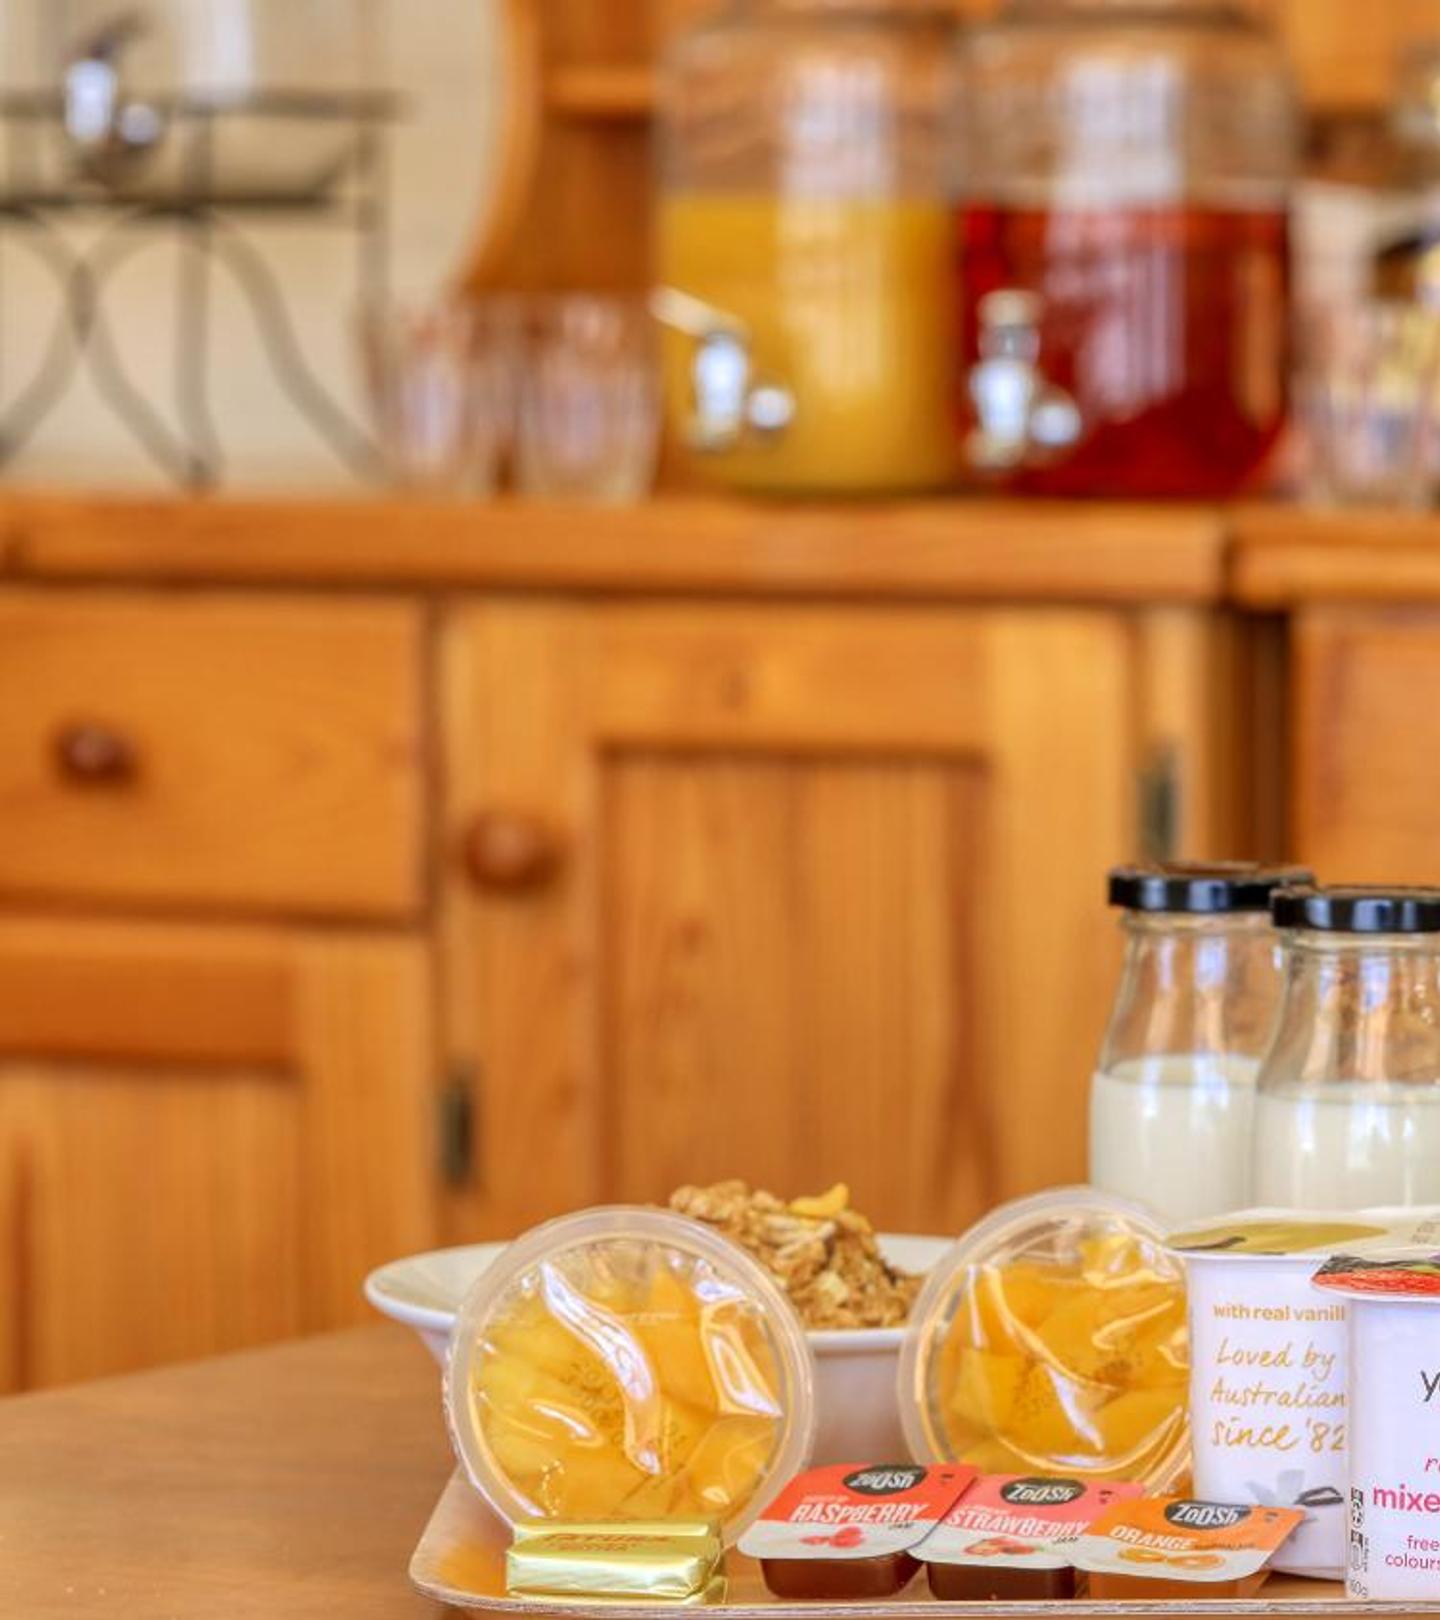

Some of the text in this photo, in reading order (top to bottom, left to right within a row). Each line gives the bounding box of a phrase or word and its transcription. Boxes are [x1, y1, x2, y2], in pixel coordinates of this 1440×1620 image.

[1213, 1305, 1345, 1321] with real vanill
[1216, 1336, 1336, 1383] Loved by
[1210, 1377, 1346, 1408] Australian
[1212, 1416, 1301, 1451] since
[790, 1502, 930, 1524] RASPBERRY
[948, 1508, 1092, 1538] STRAWBERRY
[1109, 1523, 1200, 1550] ORANGE
[1406, 1535, 1440, 1551] free
